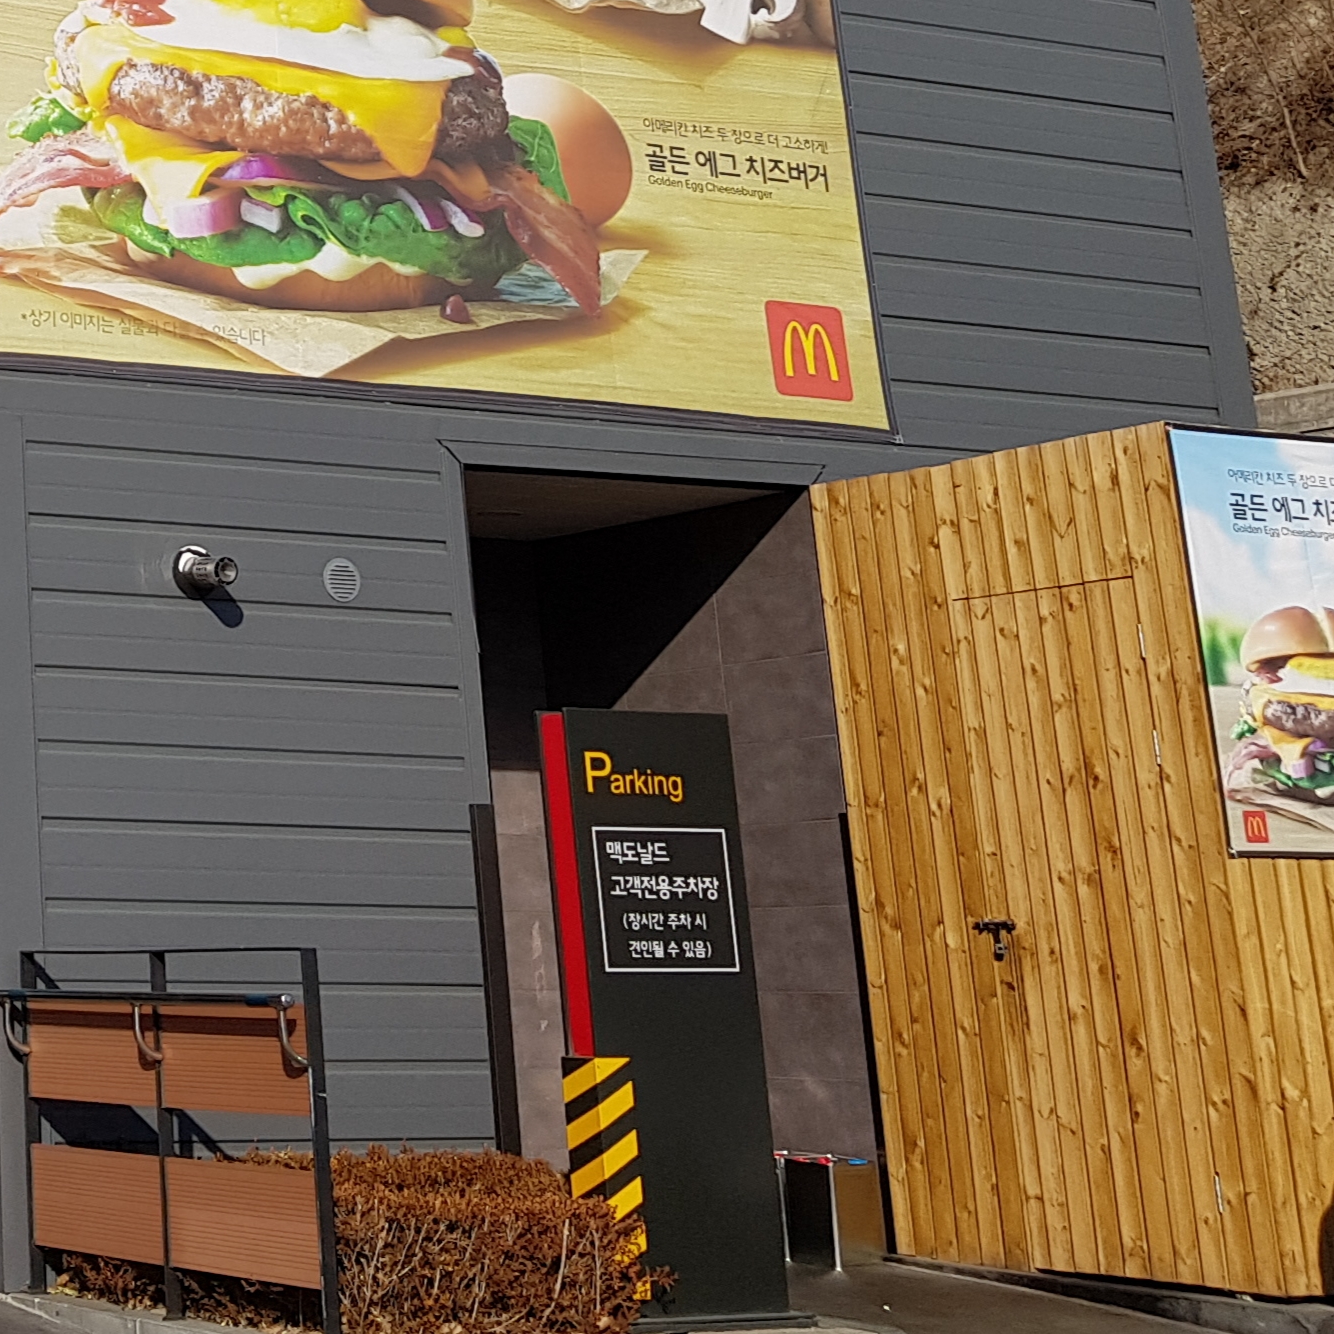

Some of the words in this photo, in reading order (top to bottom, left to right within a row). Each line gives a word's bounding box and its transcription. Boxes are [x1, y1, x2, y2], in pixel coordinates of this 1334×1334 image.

[642, 117, 689, 138] 아메리칸
[691, 123, 715, 139] 치즈
[716, 127, 729, 142] 두
[730, 130, 766, 145] 장으로
[767, 134, 779, 148] 더
[645, 143, 691, 176] 골든
[695, 149, 741, 178] 에그
[745, 155, 830, 193] 치즈버거
[648, 174, 684, 188] Golden
[685, 179, 704, 193] Egg
[705, 181, 773, 200] Cheeseburger
[59, 311, 115, 334] 이미지는
[1266, 471, 1287, 485] 치즈
[1287, 473, 1297, 487] 두
[1299, 474, 1329, 489] 장으로
[1229, 492, 1269, 522] 골든
[1272, 496, 1310, 523] 에그
[1312, 499, 1334, 526] 치
[1232, 522, 1263, 534] Golden
[1264, 526, 1281, 538] Egg
[583, 750, 684, 803] Parking
[605, 841, 670, 864] 맥도날드
[610, 876, 720, 900] 고객전용주차장
[622, 912, 664, 931] (장시간
[667, 913, 692, 931] 주차
[694, 913, 707, 930] 시
[628, 940, 664, 958] 견인될
[667, 941, 680, 958] 수
[682, 940, 712, 958] 있음)
